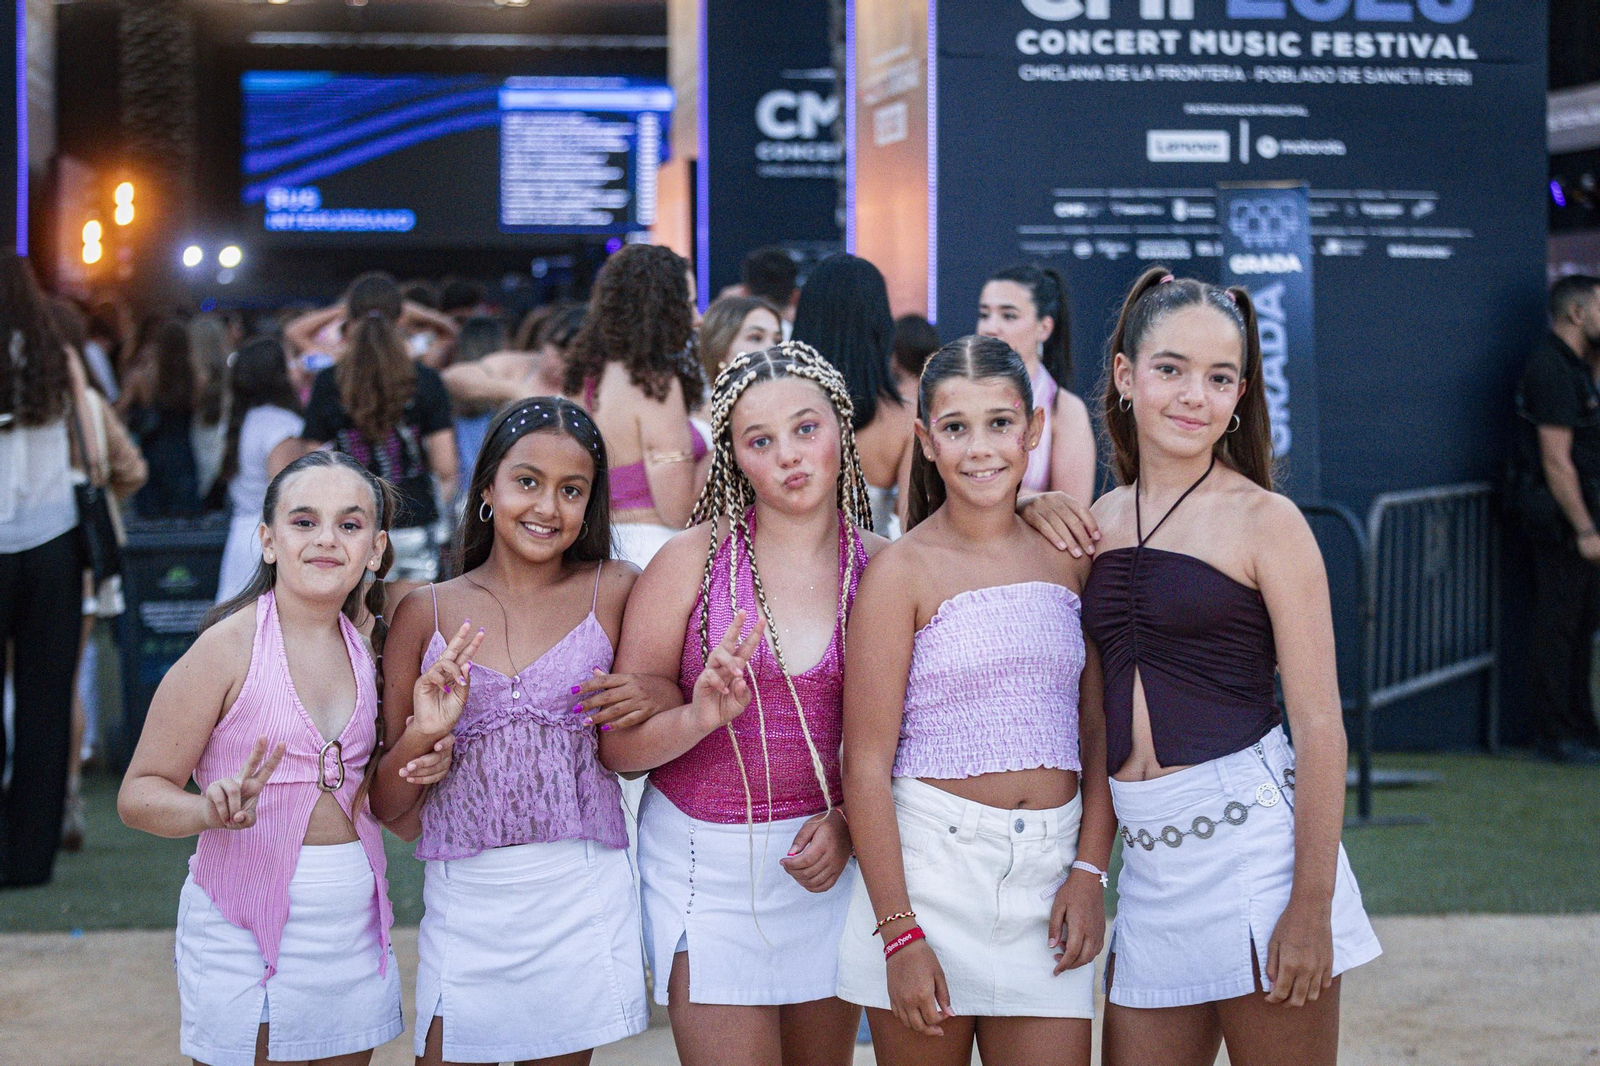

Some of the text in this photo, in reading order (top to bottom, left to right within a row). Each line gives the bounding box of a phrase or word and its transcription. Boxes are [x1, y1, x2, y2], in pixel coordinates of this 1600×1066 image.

[1016, 29, 1478, 60] CONCERT MUSIC FESTIVAL
[754, 89, 839, 139] CM
